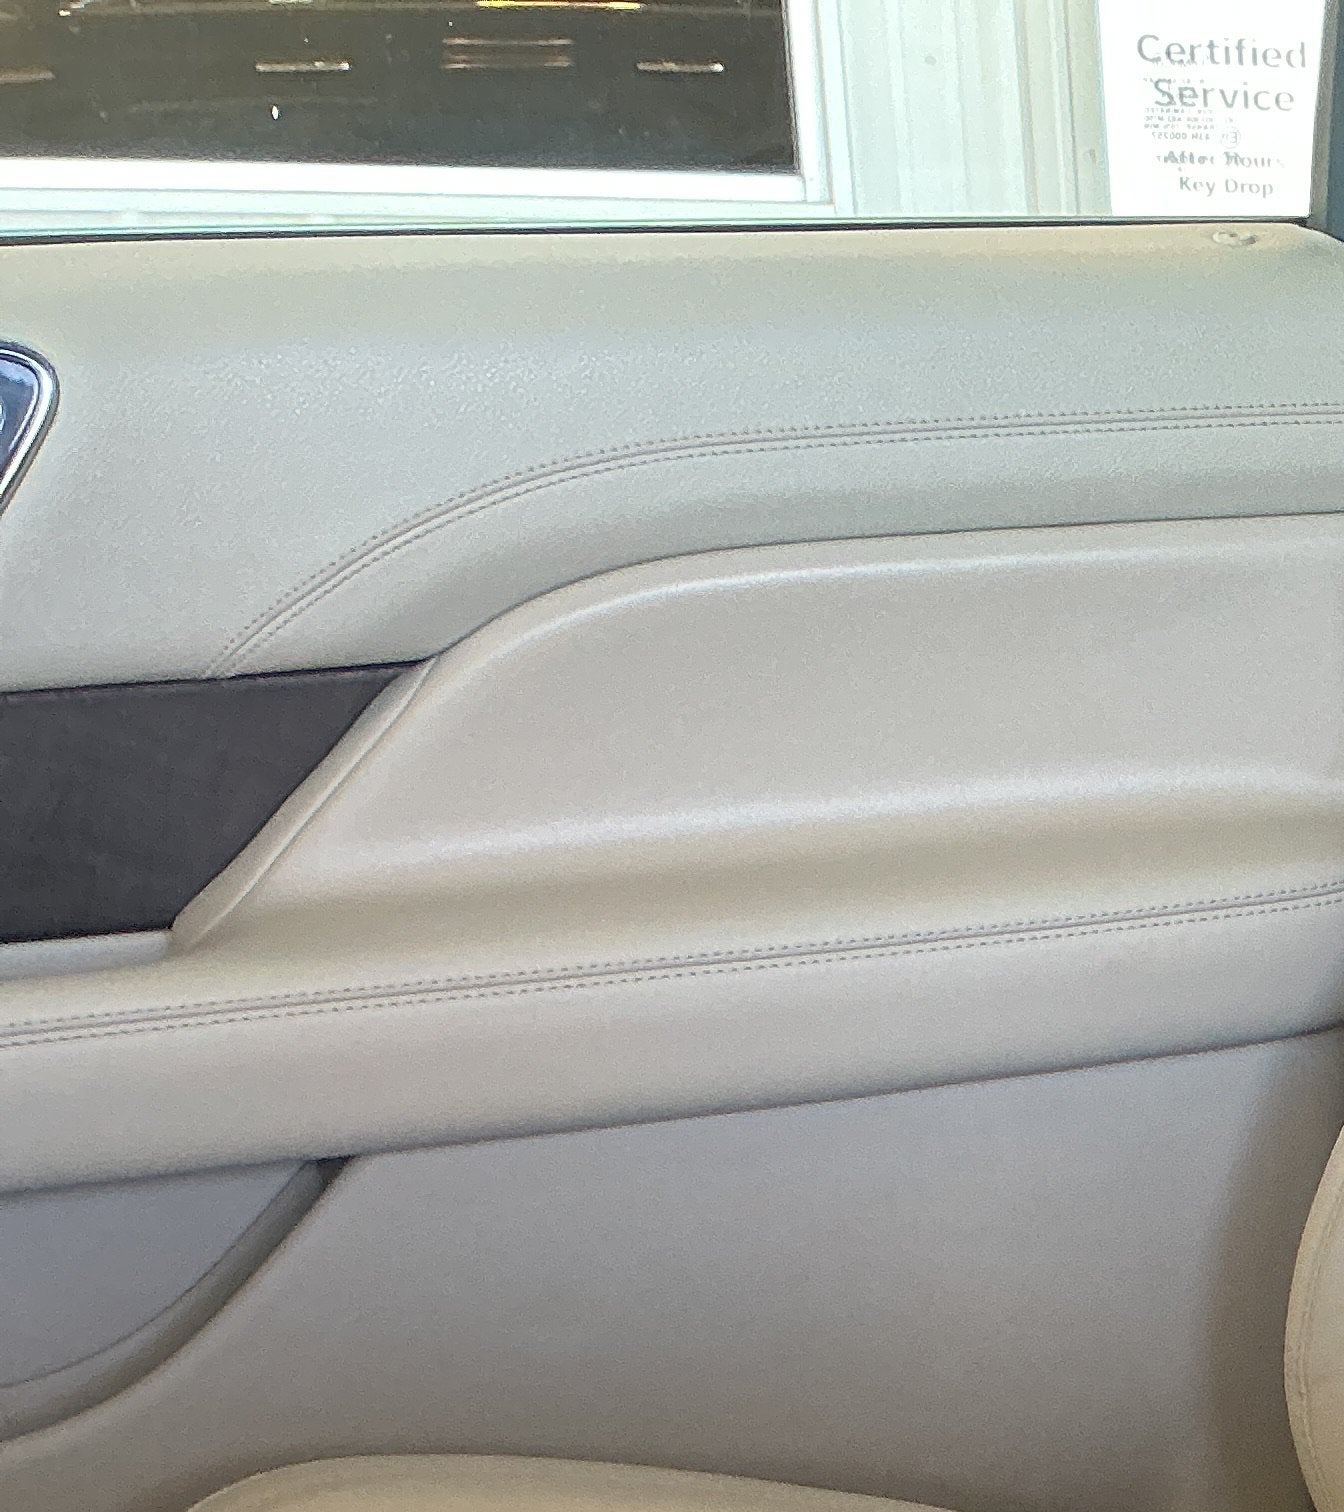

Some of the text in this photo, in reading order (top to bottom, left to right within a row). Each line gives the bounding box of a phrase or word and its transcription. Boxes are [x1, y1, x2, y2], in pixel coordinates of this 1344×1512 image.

[1136, 34, 1307, 69] Certified
[1153, 78, 1295, 111] Service
[1179, 176, 1274, 198] Key Drop
